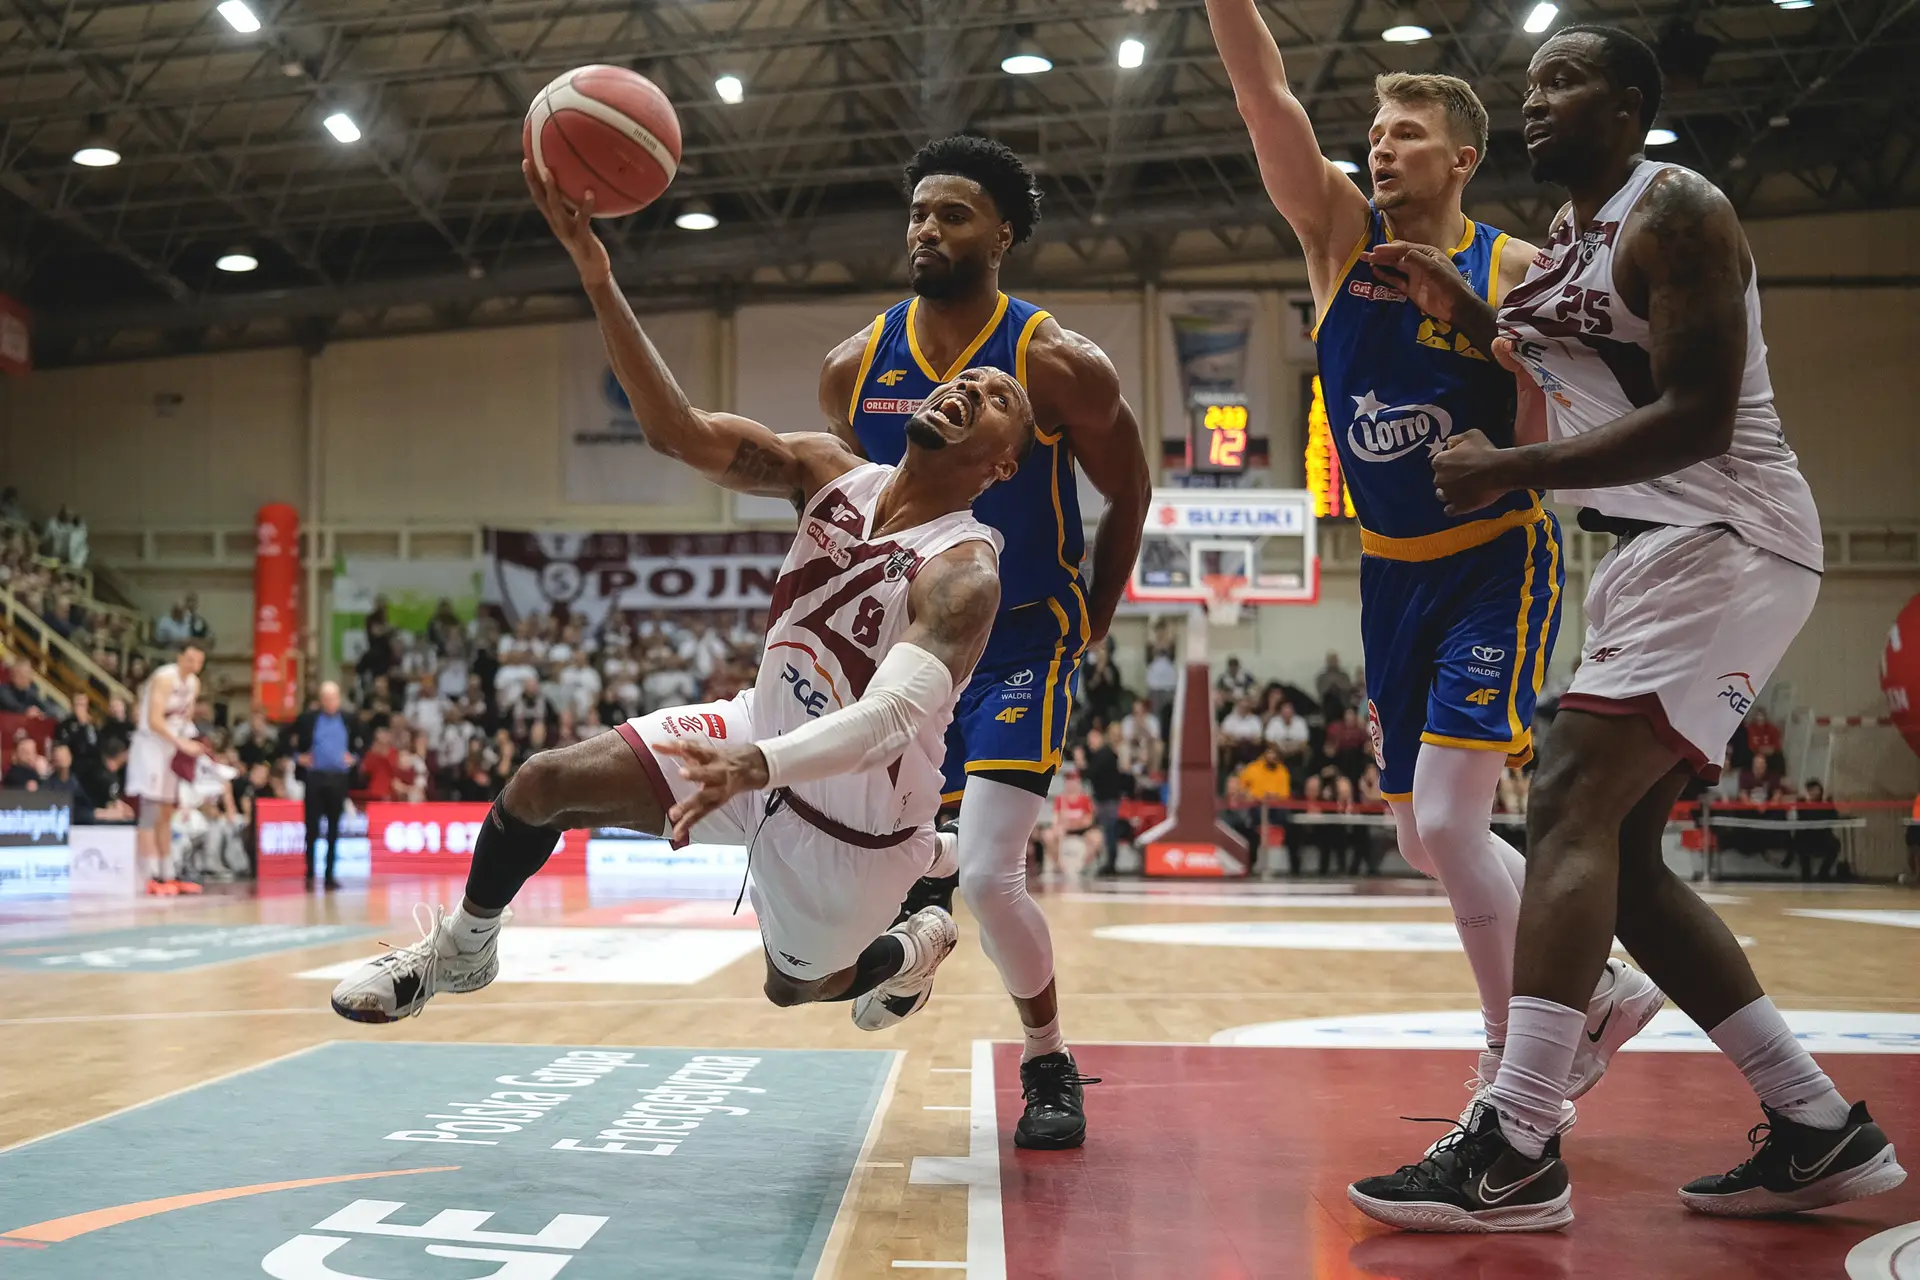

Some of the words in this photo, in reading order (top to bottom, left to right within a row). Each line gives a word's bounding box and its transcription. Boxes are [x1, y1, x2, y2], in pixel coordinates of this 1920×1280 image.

[1555, 283, 1614, 335] 25
[877, 369, 907, 386] 4F
[866, 402, 895, 410] ORLEN
[1361, 413, 1430, 452] LOTTO
[1209, 429, 1247, 467] 12
[1188, 507, 1292, 524] SUZUKI
[852, 595, 884, 649] 8
[1588, 646, 1623, 663] 4F
[1467, 665, 1501, 679] WALDER
[1001, 692, 1032, 700] WALDER
[1465, 688, 1500, 706] 4F
[1717, 684, 1751, 716] PGE
[994, 706, 1029, 724] 4F
[778, 950, 812, 967] 4F
[382, 1092, 573, 1146] Polska
[495, 1050, 650, 1088] Grupa
[550, 1055, 767, 1156] Energetyczna
